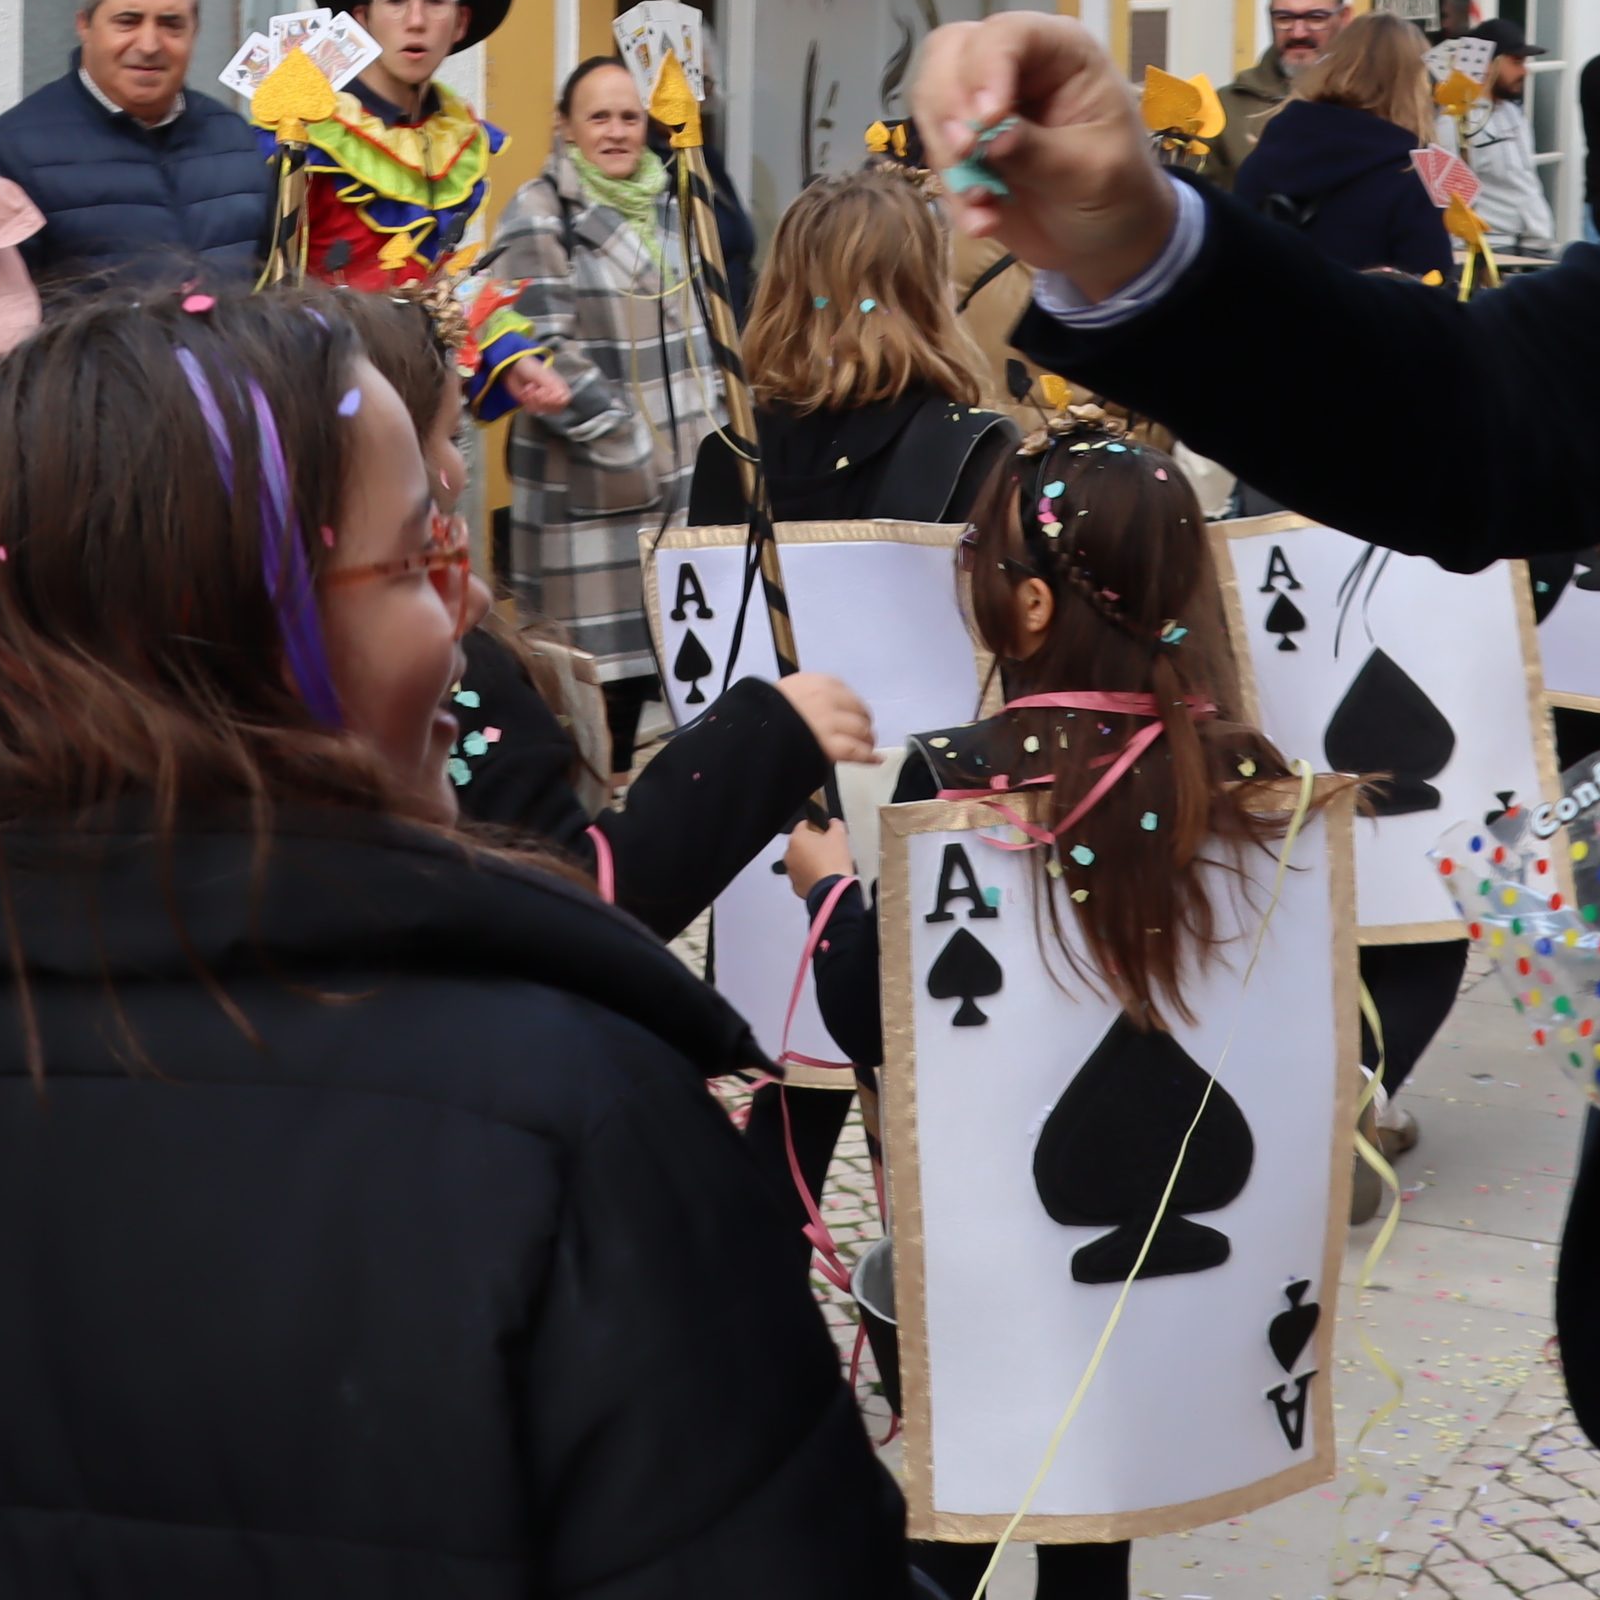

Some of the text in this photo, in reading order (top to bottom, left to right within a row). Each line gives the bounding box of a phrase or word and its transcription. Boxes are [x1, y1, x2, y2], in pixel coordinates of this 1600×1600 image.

[670, 562, 714, 621] A
[1260, 545, 1303, 592] A
[925, 843, 998, 922] A
[1266, 1370, 1317, 1450] A
